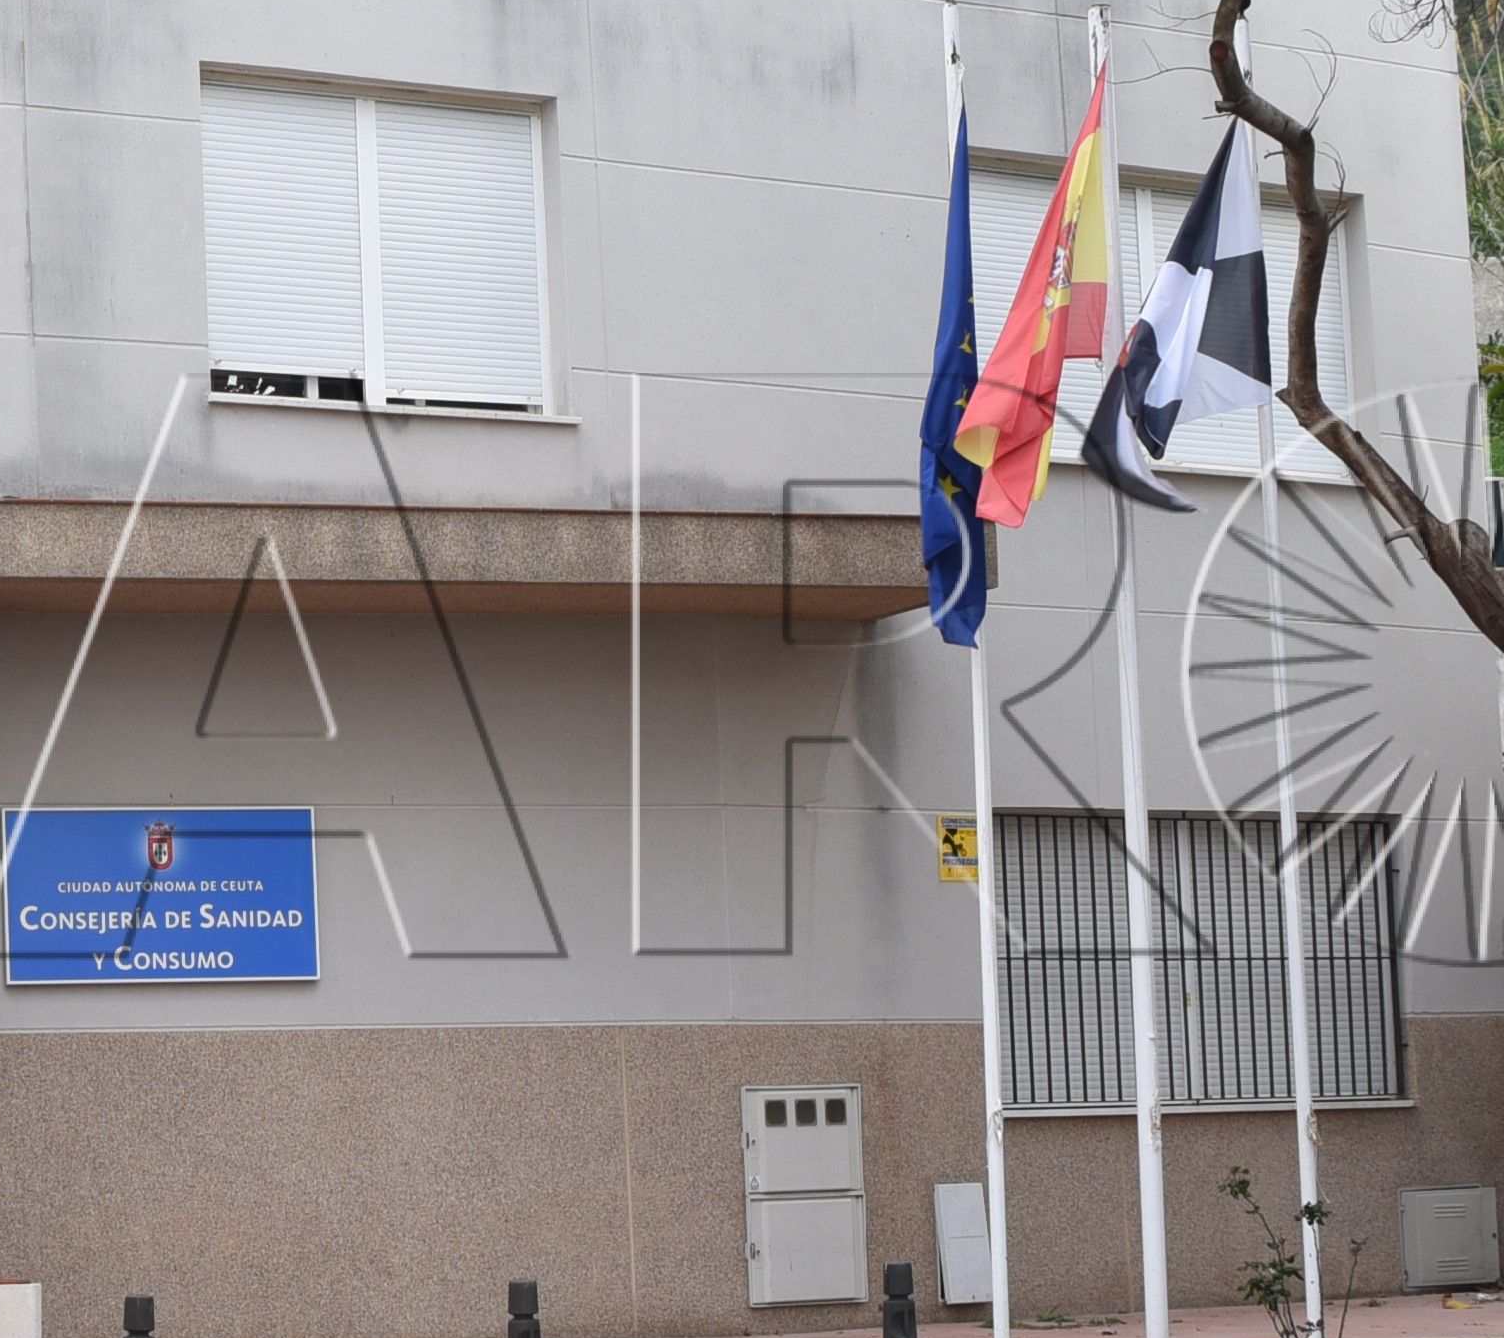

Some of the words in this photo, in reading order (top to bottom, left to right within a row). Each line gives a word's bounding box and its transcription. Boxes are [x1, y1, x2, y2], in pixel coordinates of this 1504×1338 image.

[57, 881, 112, 894] CIUDAD
[115, 878, 197, 894] AUTÓNOMA
[200, 880, 218, 892] DE
[221, 879, 264, 892] CEUTA
[164, 910, 192, 929] DE
